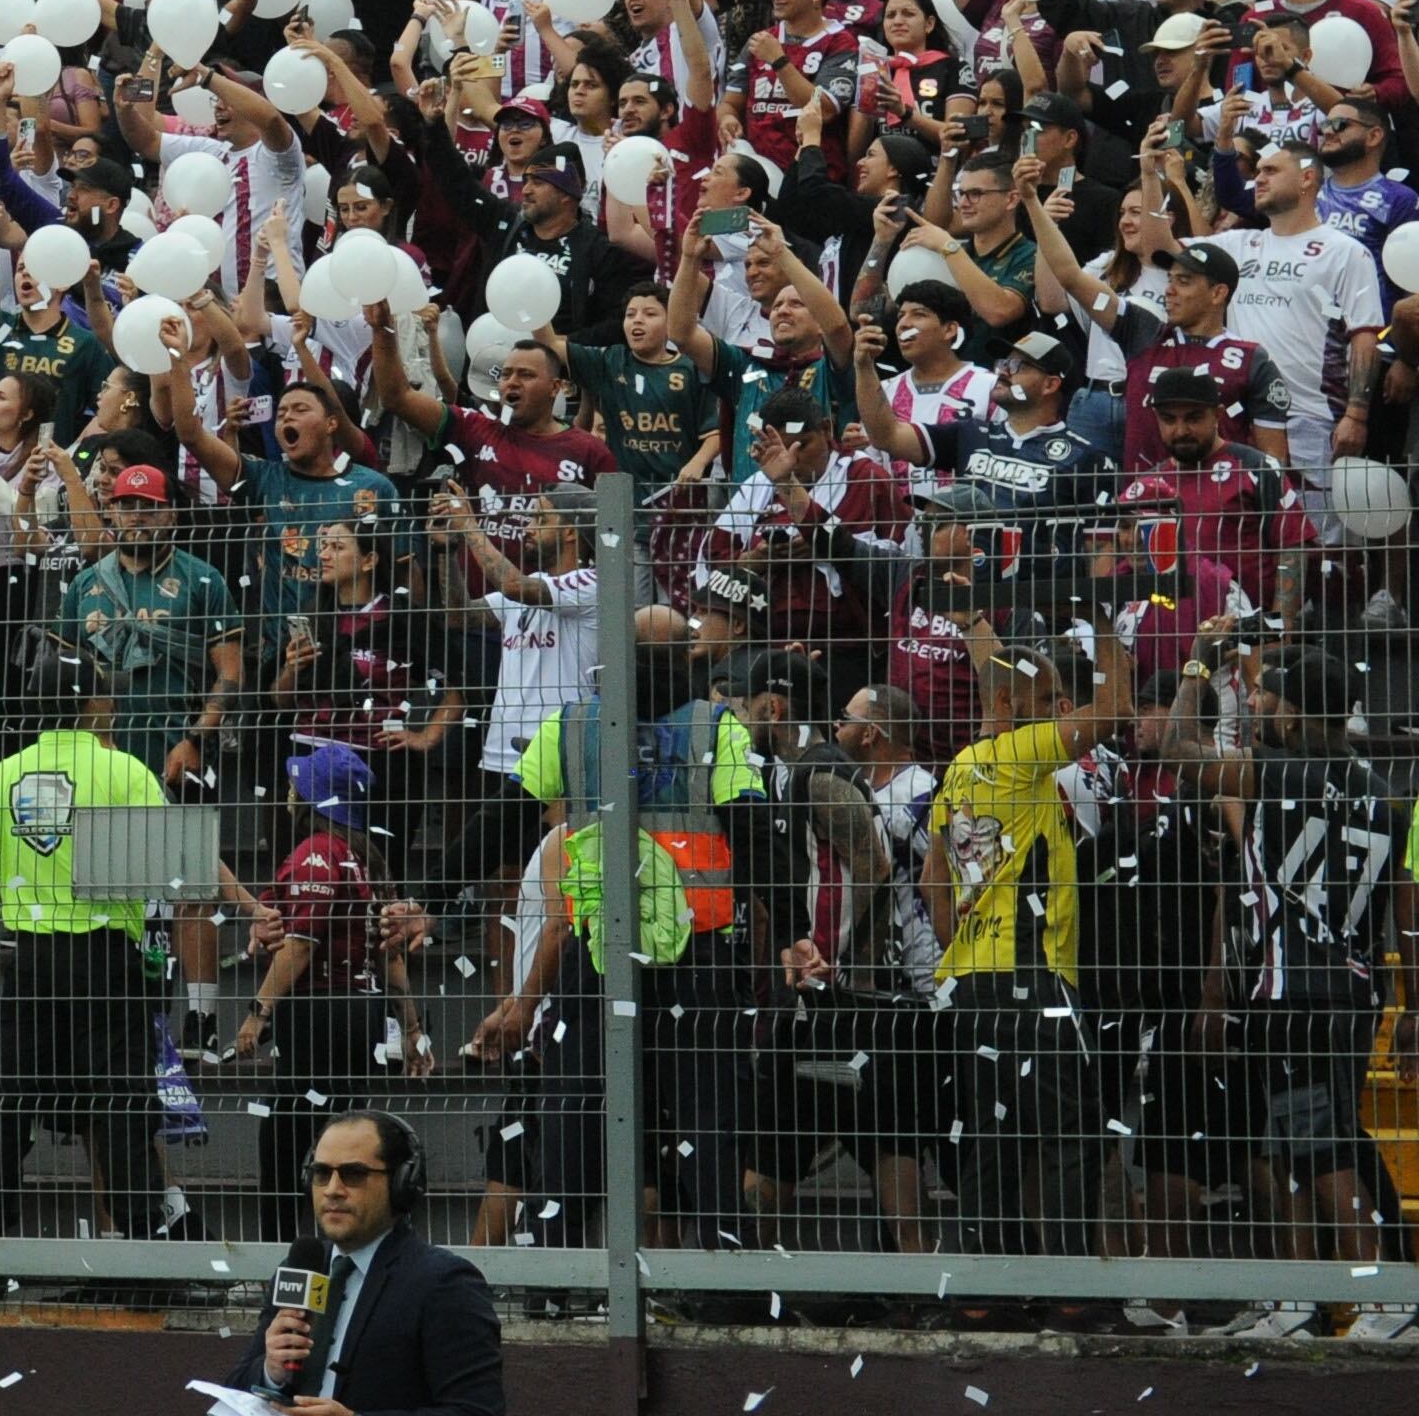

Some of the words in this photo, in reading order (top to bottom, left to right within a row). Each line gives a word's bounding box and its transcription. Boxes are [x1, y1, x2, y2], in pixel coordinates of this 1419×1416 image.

[845, 6, 864, 20] S
[804, 52, 823, 73] S
[919, 78, 937, 96] S
[1361, 192, 1383, 208] S
[1327, 213, 1369, 232] BAC
[1305, 241, 1323, 257] S
[539, 252, 571, 270] BAC
[1267, 261, 1306, 278] BAC
[1237, 294, 1293, 308] LIBERTY
[57, 336, 75, 352] S
[22, 357, 66, 377] BAC
[1222, 347, 1245, 370] S
[669, 373, 684, 391] S
[637, 413, 681, 432] BAC
[623, 439, 683, 454] LIBERTY
[557, 460, 577, 481] S
[975, 454, 1050, 487] BIMBO
[1211, 462, 1232, 482] S
[511, 495, 539, 514] BA
[281, 568, 321, 582] LIBE
[137, 608, 171, 625] AC
[898, 641, 965, 662] LIBERTY
[1278, 816, 1391, 936] 47
[279, 1281, 303, 1292] FUTV
